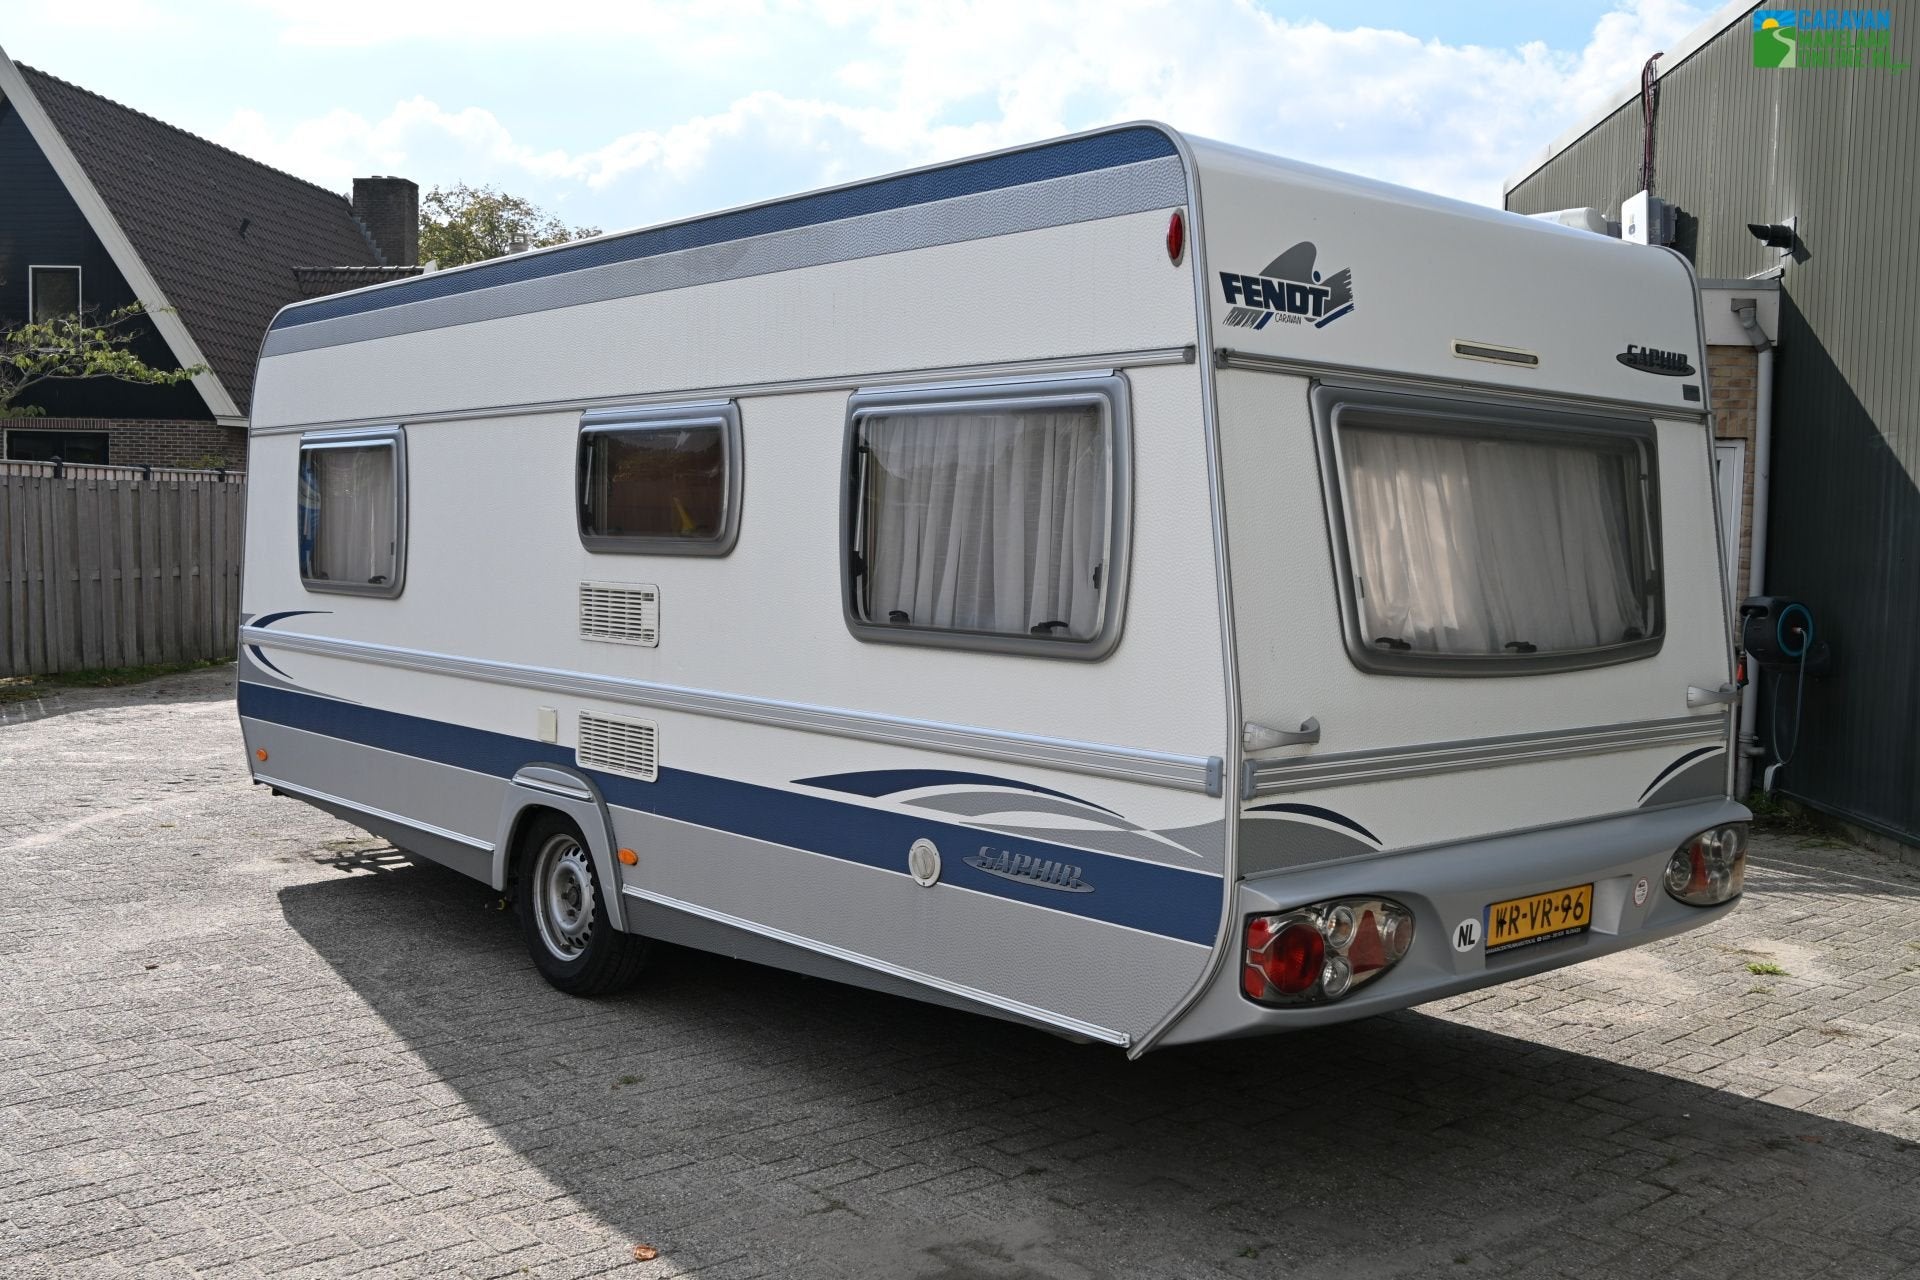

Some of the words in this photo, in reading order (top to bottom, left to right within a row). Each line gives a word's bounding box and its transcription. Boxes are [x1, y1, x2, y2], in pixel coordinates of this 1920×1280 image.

[1219, 271, 1330, 318] FENDT
[1274, 312, 1302, 325] CARAVAN
[975, 846, 1082, 890] SAPHIR
[1457, 923, 1476, 948] NL
[1495, 891, 1585, 938] WR-VR-96
